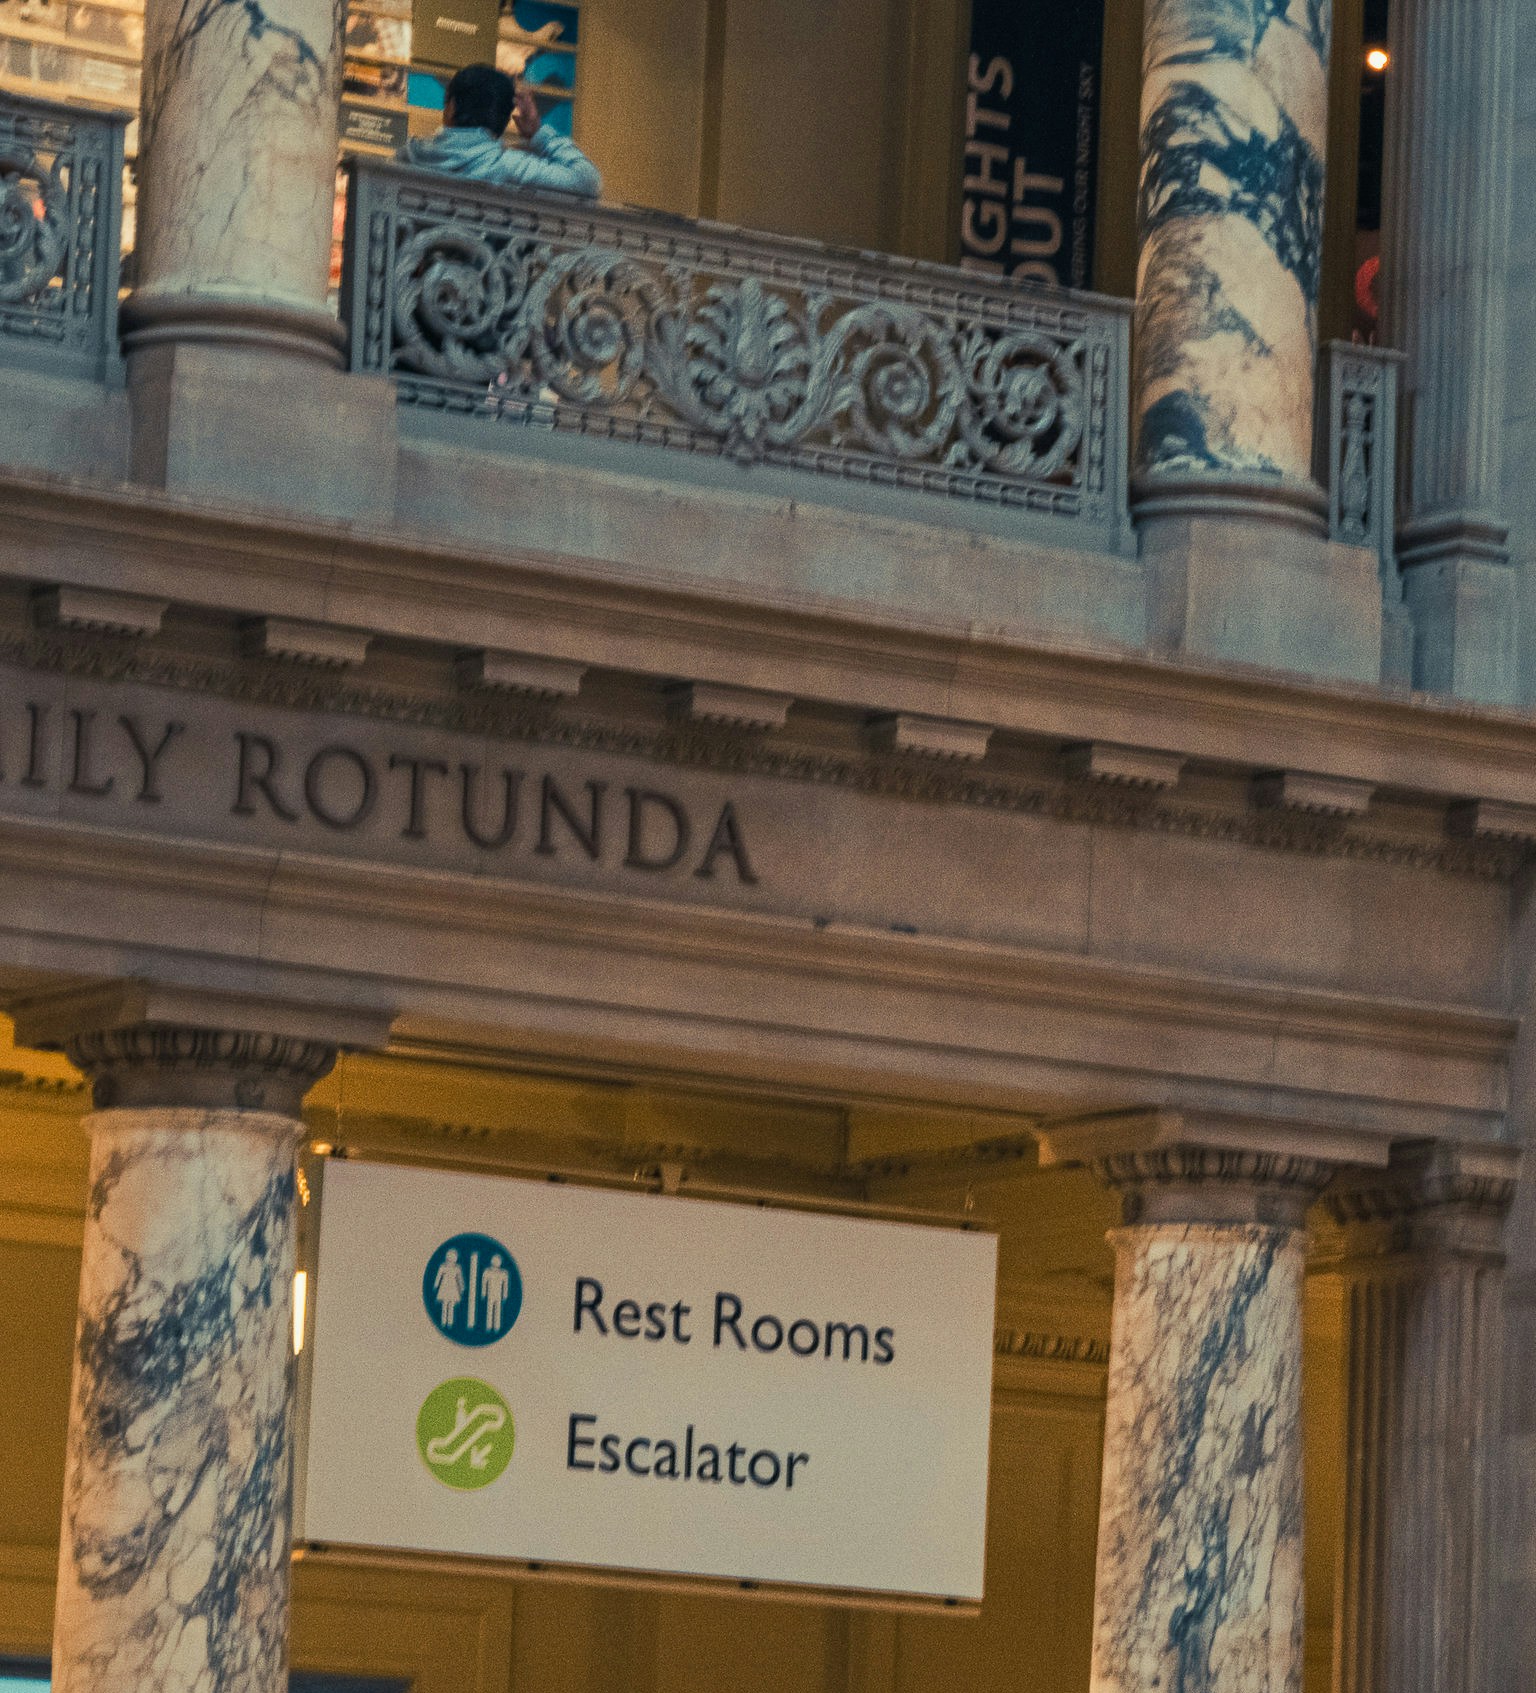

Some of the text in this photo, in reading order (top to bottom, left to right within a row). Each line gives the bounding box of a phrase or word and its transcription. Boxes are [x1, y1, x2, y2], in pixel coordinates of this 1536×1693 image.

[960, 53, 1014, 274] IGHTS
[0, 702, 758, 884] ILY ROTUNDA
[573, 1276, 895, 1365] Rest Rooms
[567, 1412, 810, 1491] Escalator
